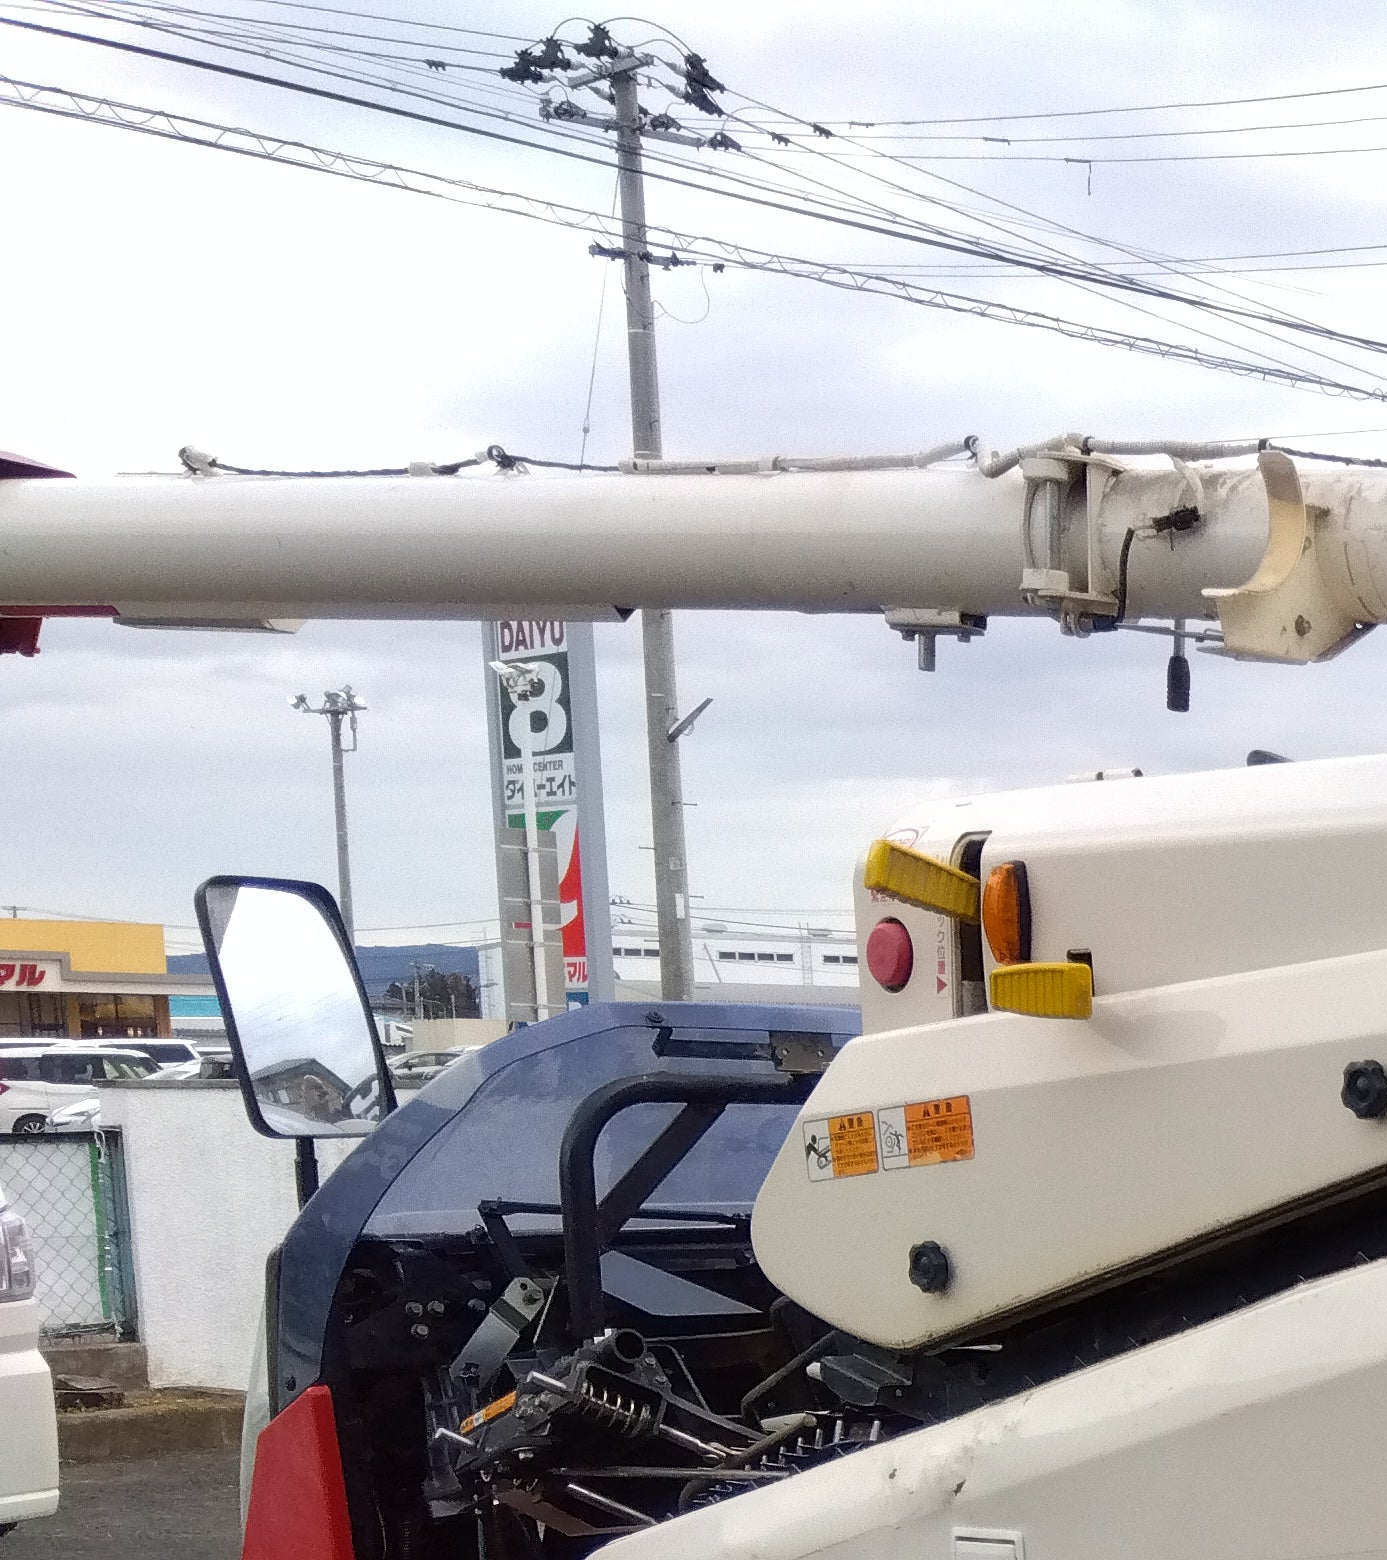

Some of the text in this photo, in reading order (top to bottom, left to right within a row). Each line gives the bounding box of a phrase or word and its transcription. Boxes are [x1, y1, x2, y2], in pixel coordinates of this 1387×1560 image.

[501, 621, 565, 653] DAIYU
[532, 760, 564, 772] CENTER
[506, 775, 576, 800] ダイーエイト
